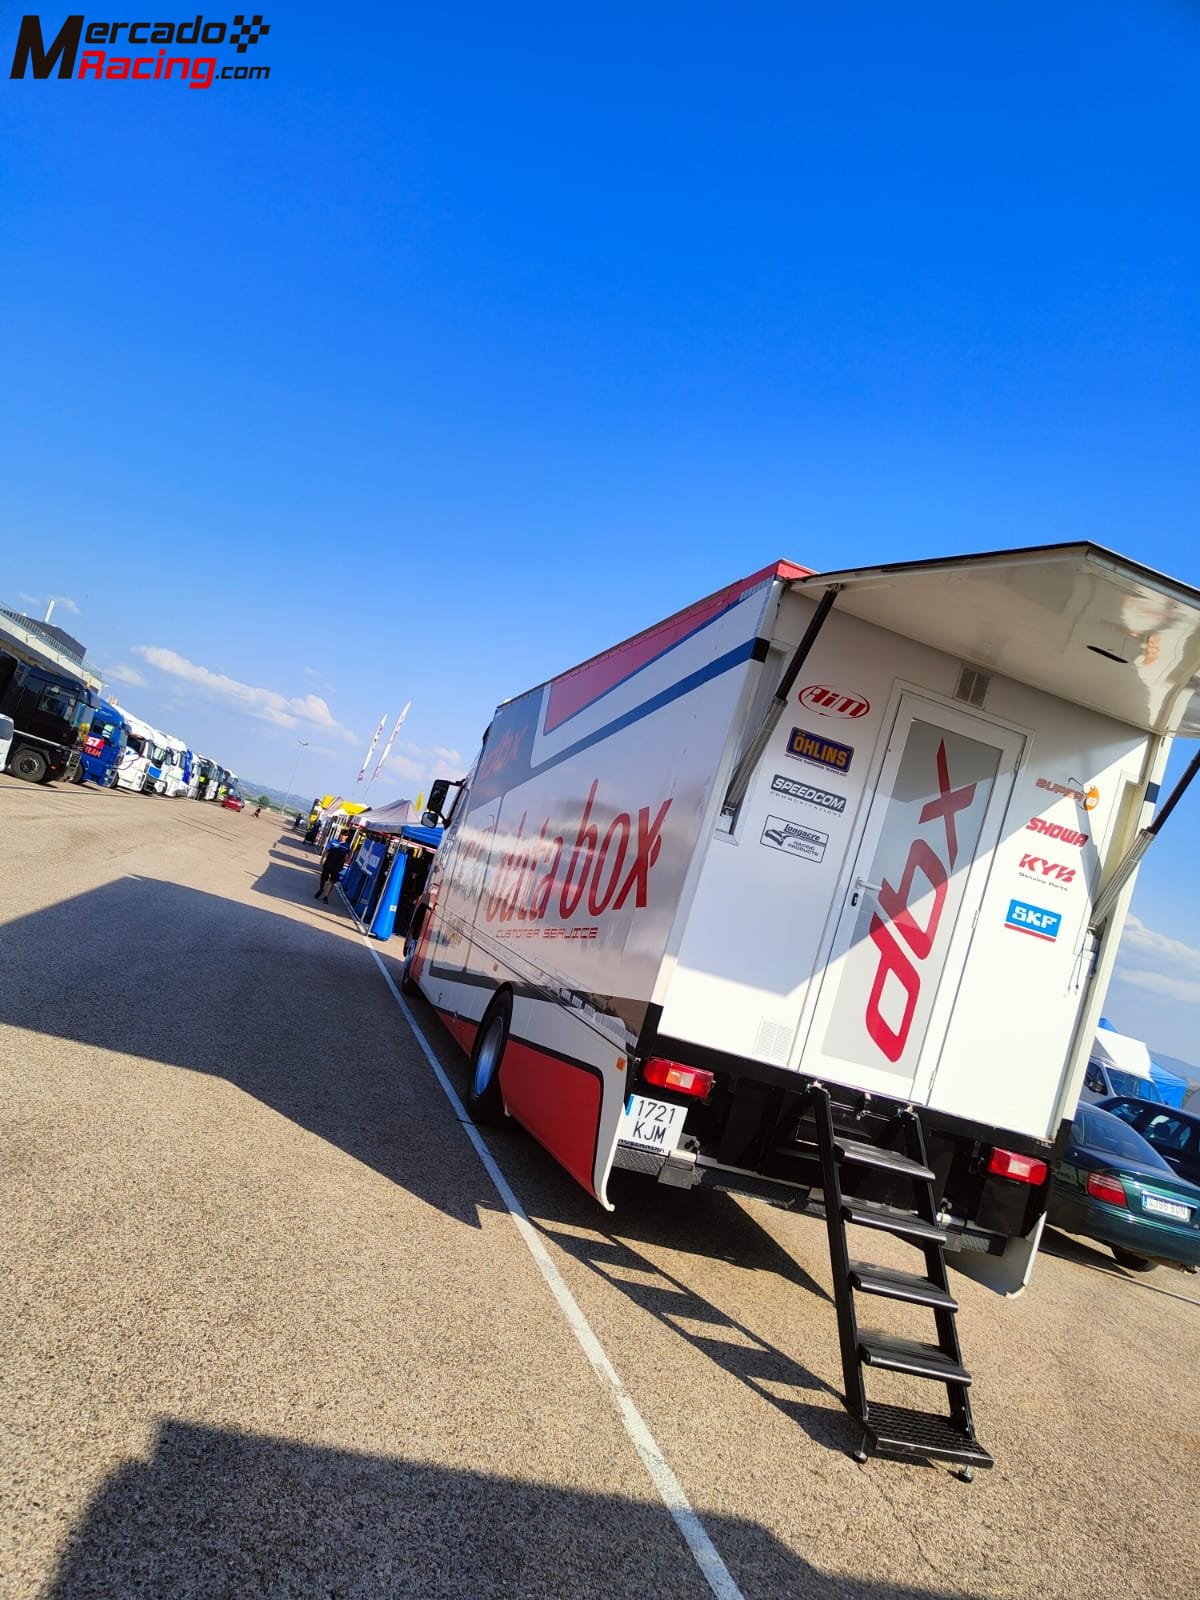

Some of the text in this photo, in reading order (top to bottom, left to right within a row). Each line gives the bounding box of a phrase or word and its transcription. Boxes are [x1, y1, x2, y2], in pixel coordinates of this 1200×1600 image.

[793, 731, 849, 768] ÖHLINS
[783, 823, 821, 842] Longacre
[1026, 816, 1089, 848] SHOWA
[1018, 853, 1077, 883] KYB
[1012, 905, 1058, 930] SKF
[543, 926, 599, 939] SERVICE
[636, 1099, 677, 1125] 1721
[632, 1120, 667, 1144] KJM
